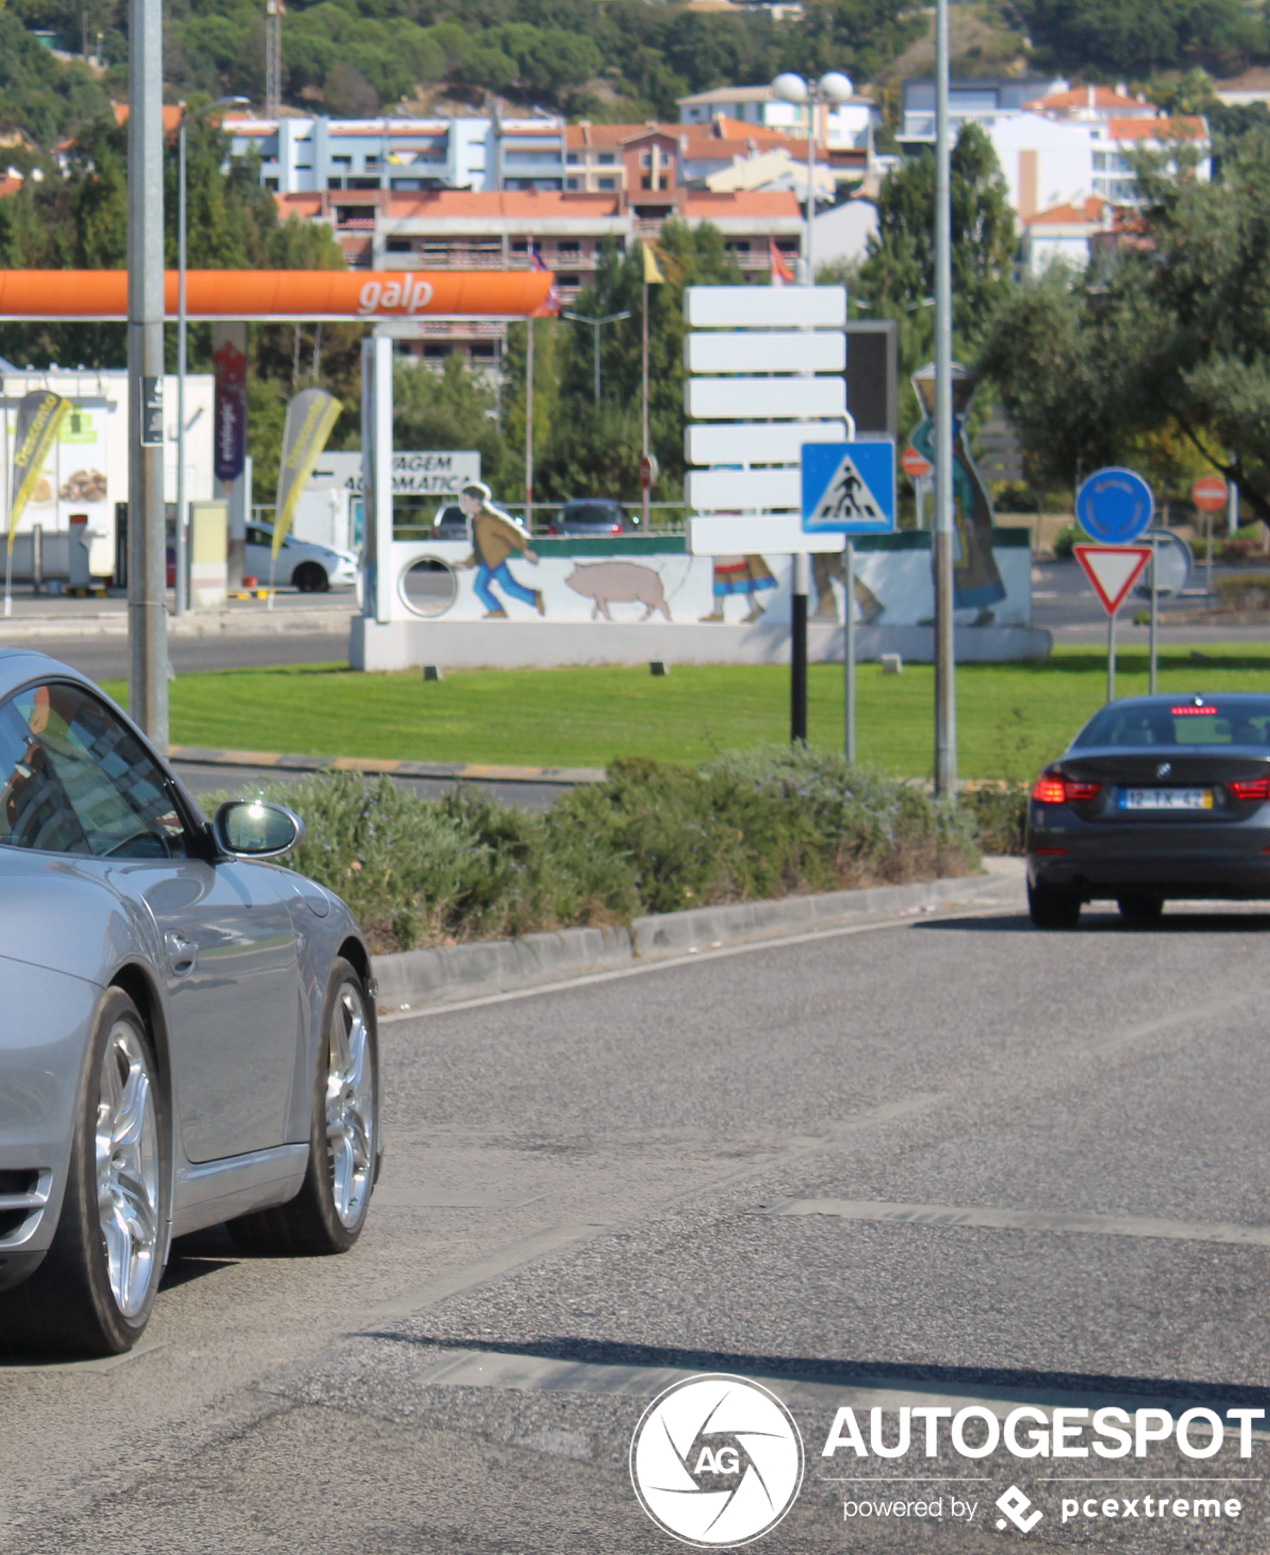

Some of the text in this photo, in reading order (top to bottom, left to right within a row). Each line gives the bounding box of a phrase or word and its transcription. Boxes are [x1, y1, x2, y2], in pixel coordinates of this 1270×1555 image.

[357, 271, 434, 315] galp
[14, 394, 58, 469] Desconto
[285, 394, 327, 469] Desconto
